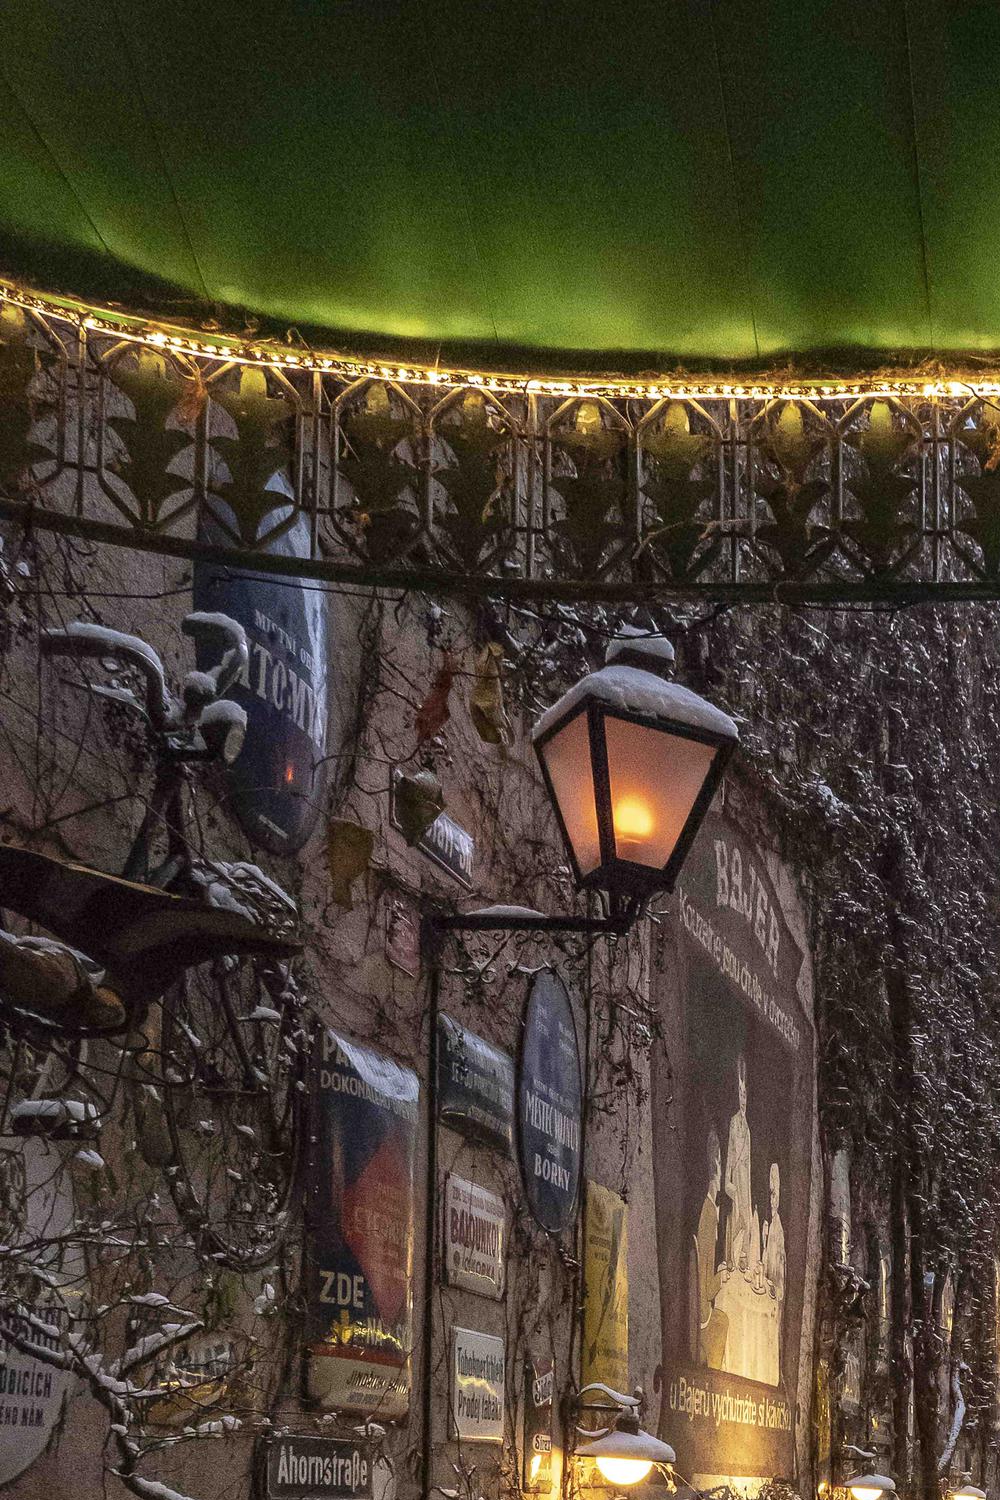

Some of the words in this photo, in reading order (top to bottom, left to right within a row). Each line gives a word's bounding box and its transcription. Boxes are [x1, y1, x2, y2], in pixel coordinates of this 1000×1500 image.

[534, 1153, 571, 1192] BORKY
[319, 1270, 365, 1309] ZDE
[277, 1444, 368, 1493] Ahornstraße
